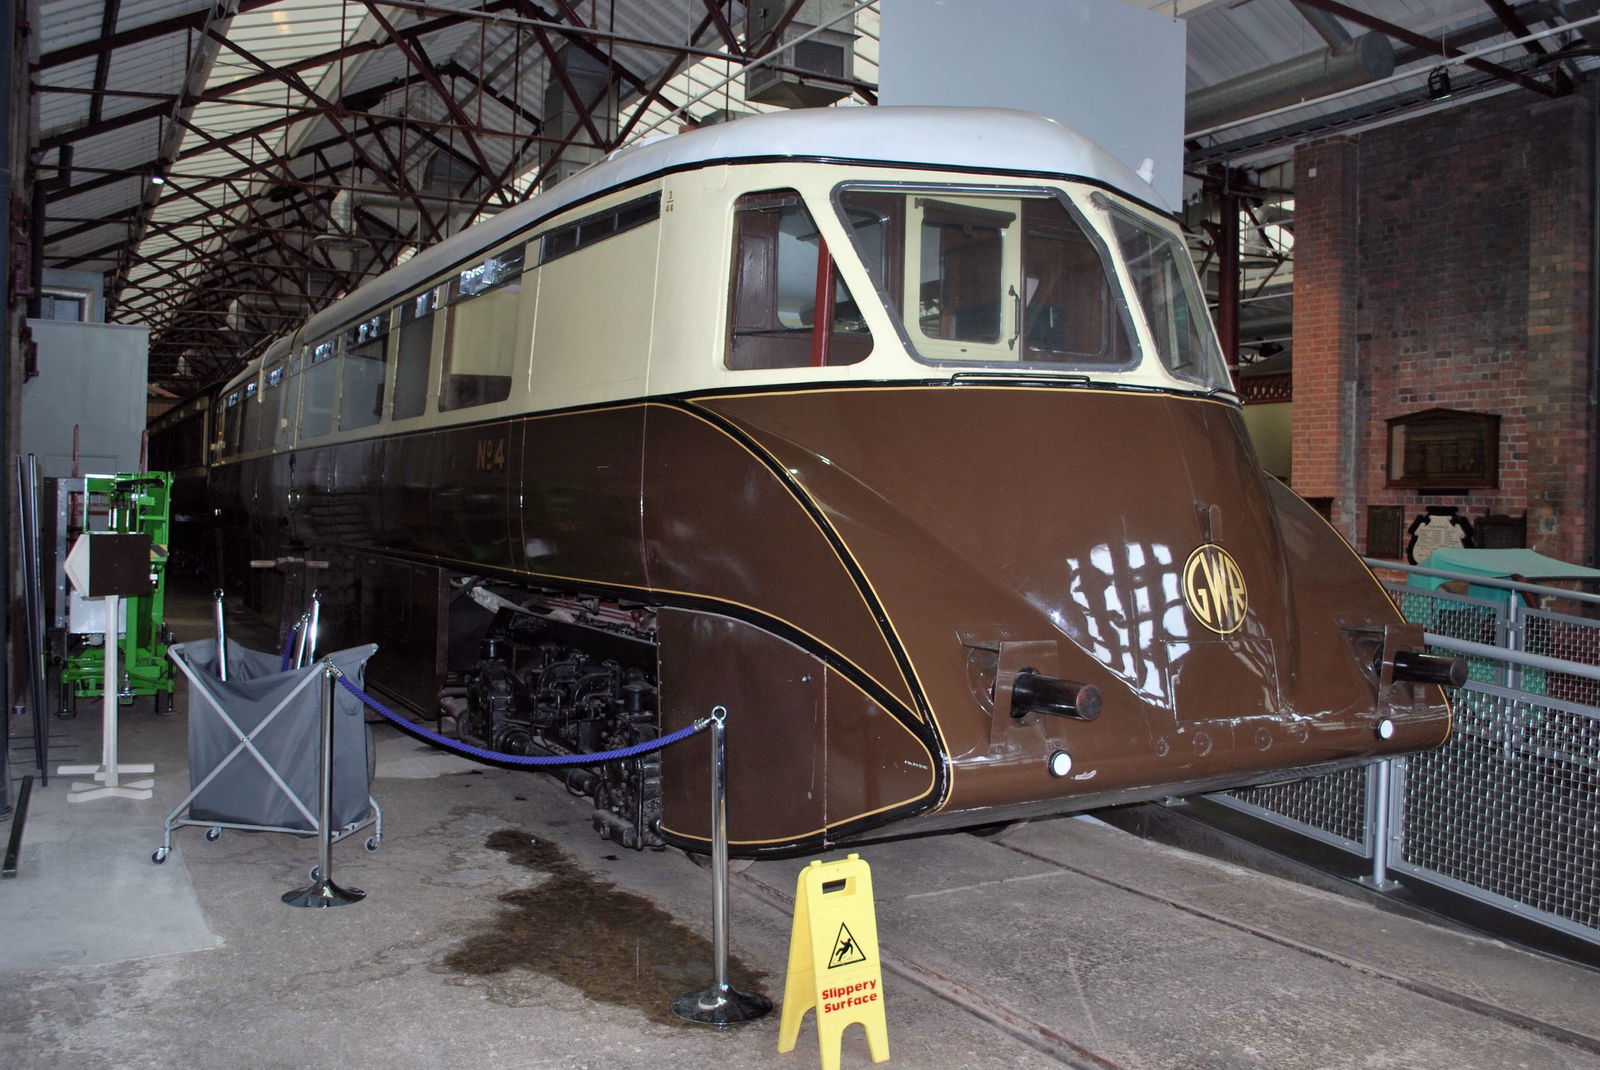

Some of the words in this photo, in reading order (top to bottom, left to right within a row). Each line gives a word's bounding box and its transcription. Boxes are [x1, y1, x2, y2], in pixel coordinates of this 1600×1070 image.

[1187, 551, 1246, 624] GWR
[821, 979, 877, 1000] Slippery
[824, 992, 878, 1014] Surface
